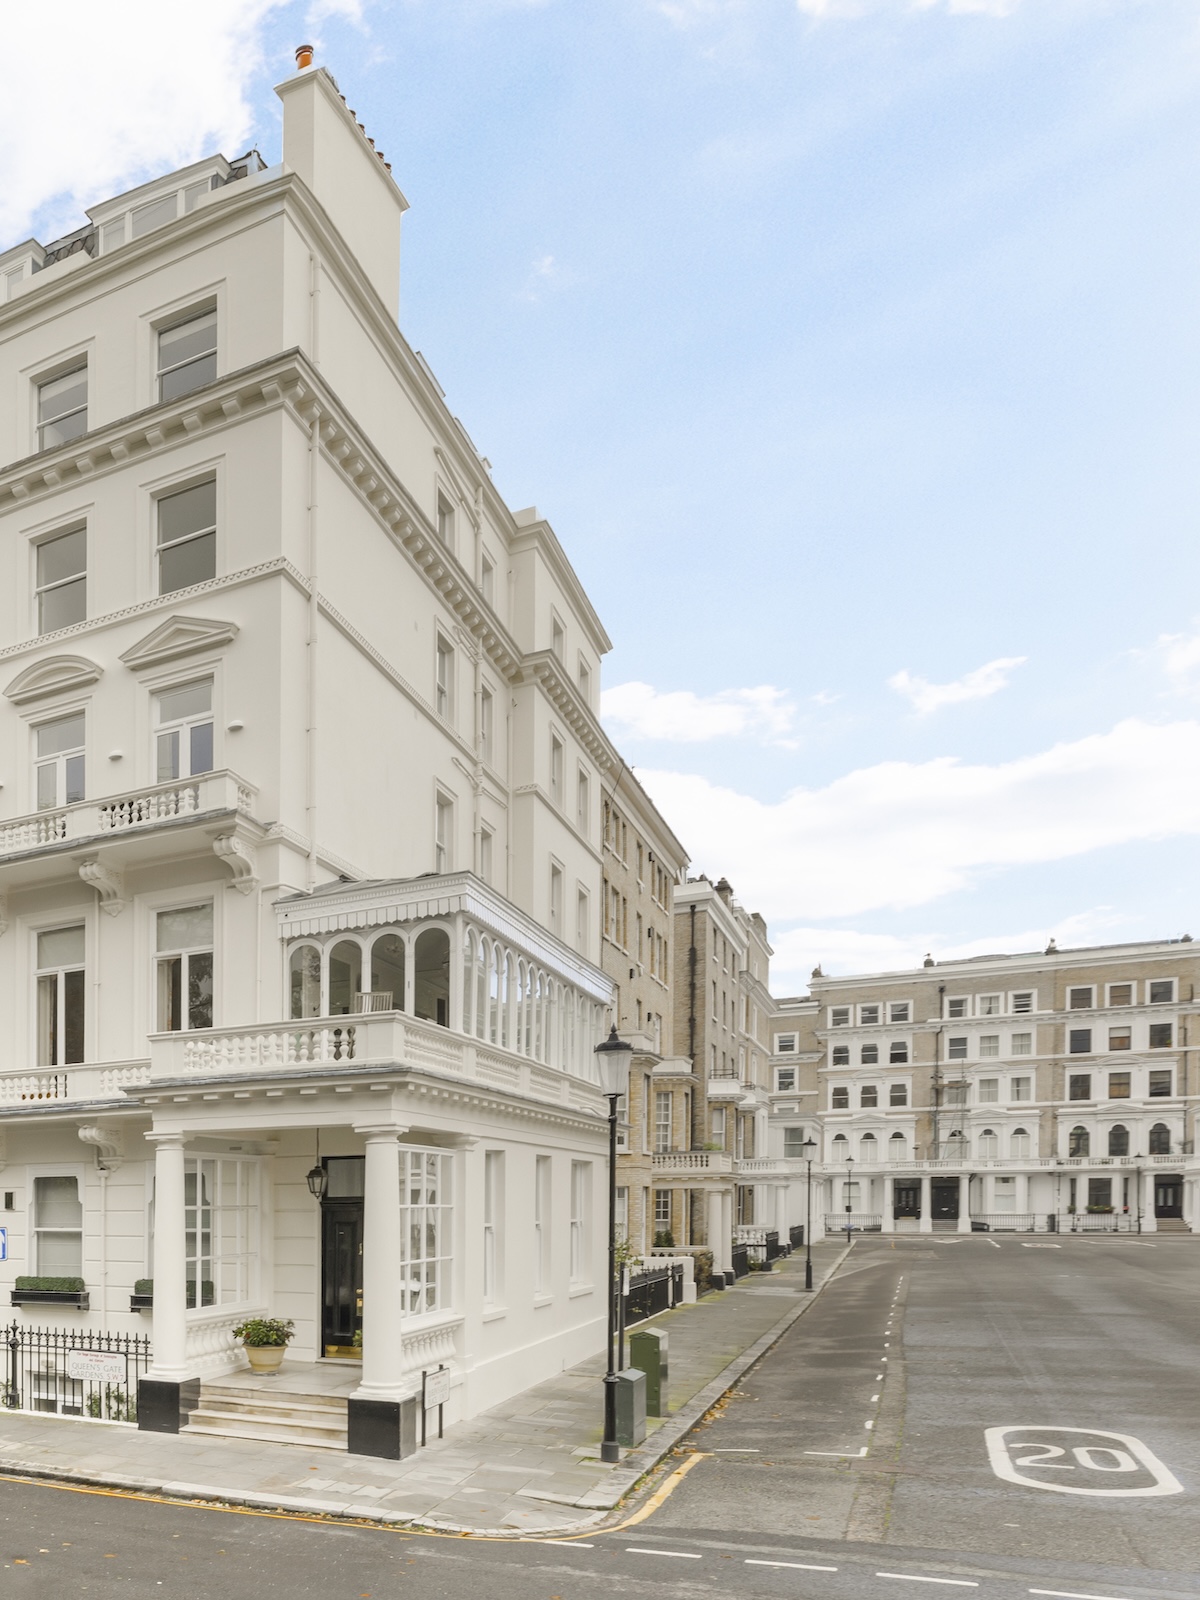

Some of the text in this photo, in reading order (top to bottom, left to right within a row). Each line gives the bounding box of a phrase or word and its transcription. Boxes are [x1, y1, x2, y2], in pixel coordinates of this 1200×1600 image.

[72, 1362, 122, 1373] QUEEN'S GATE
[1009, 1443, 1139, 1472] 20
